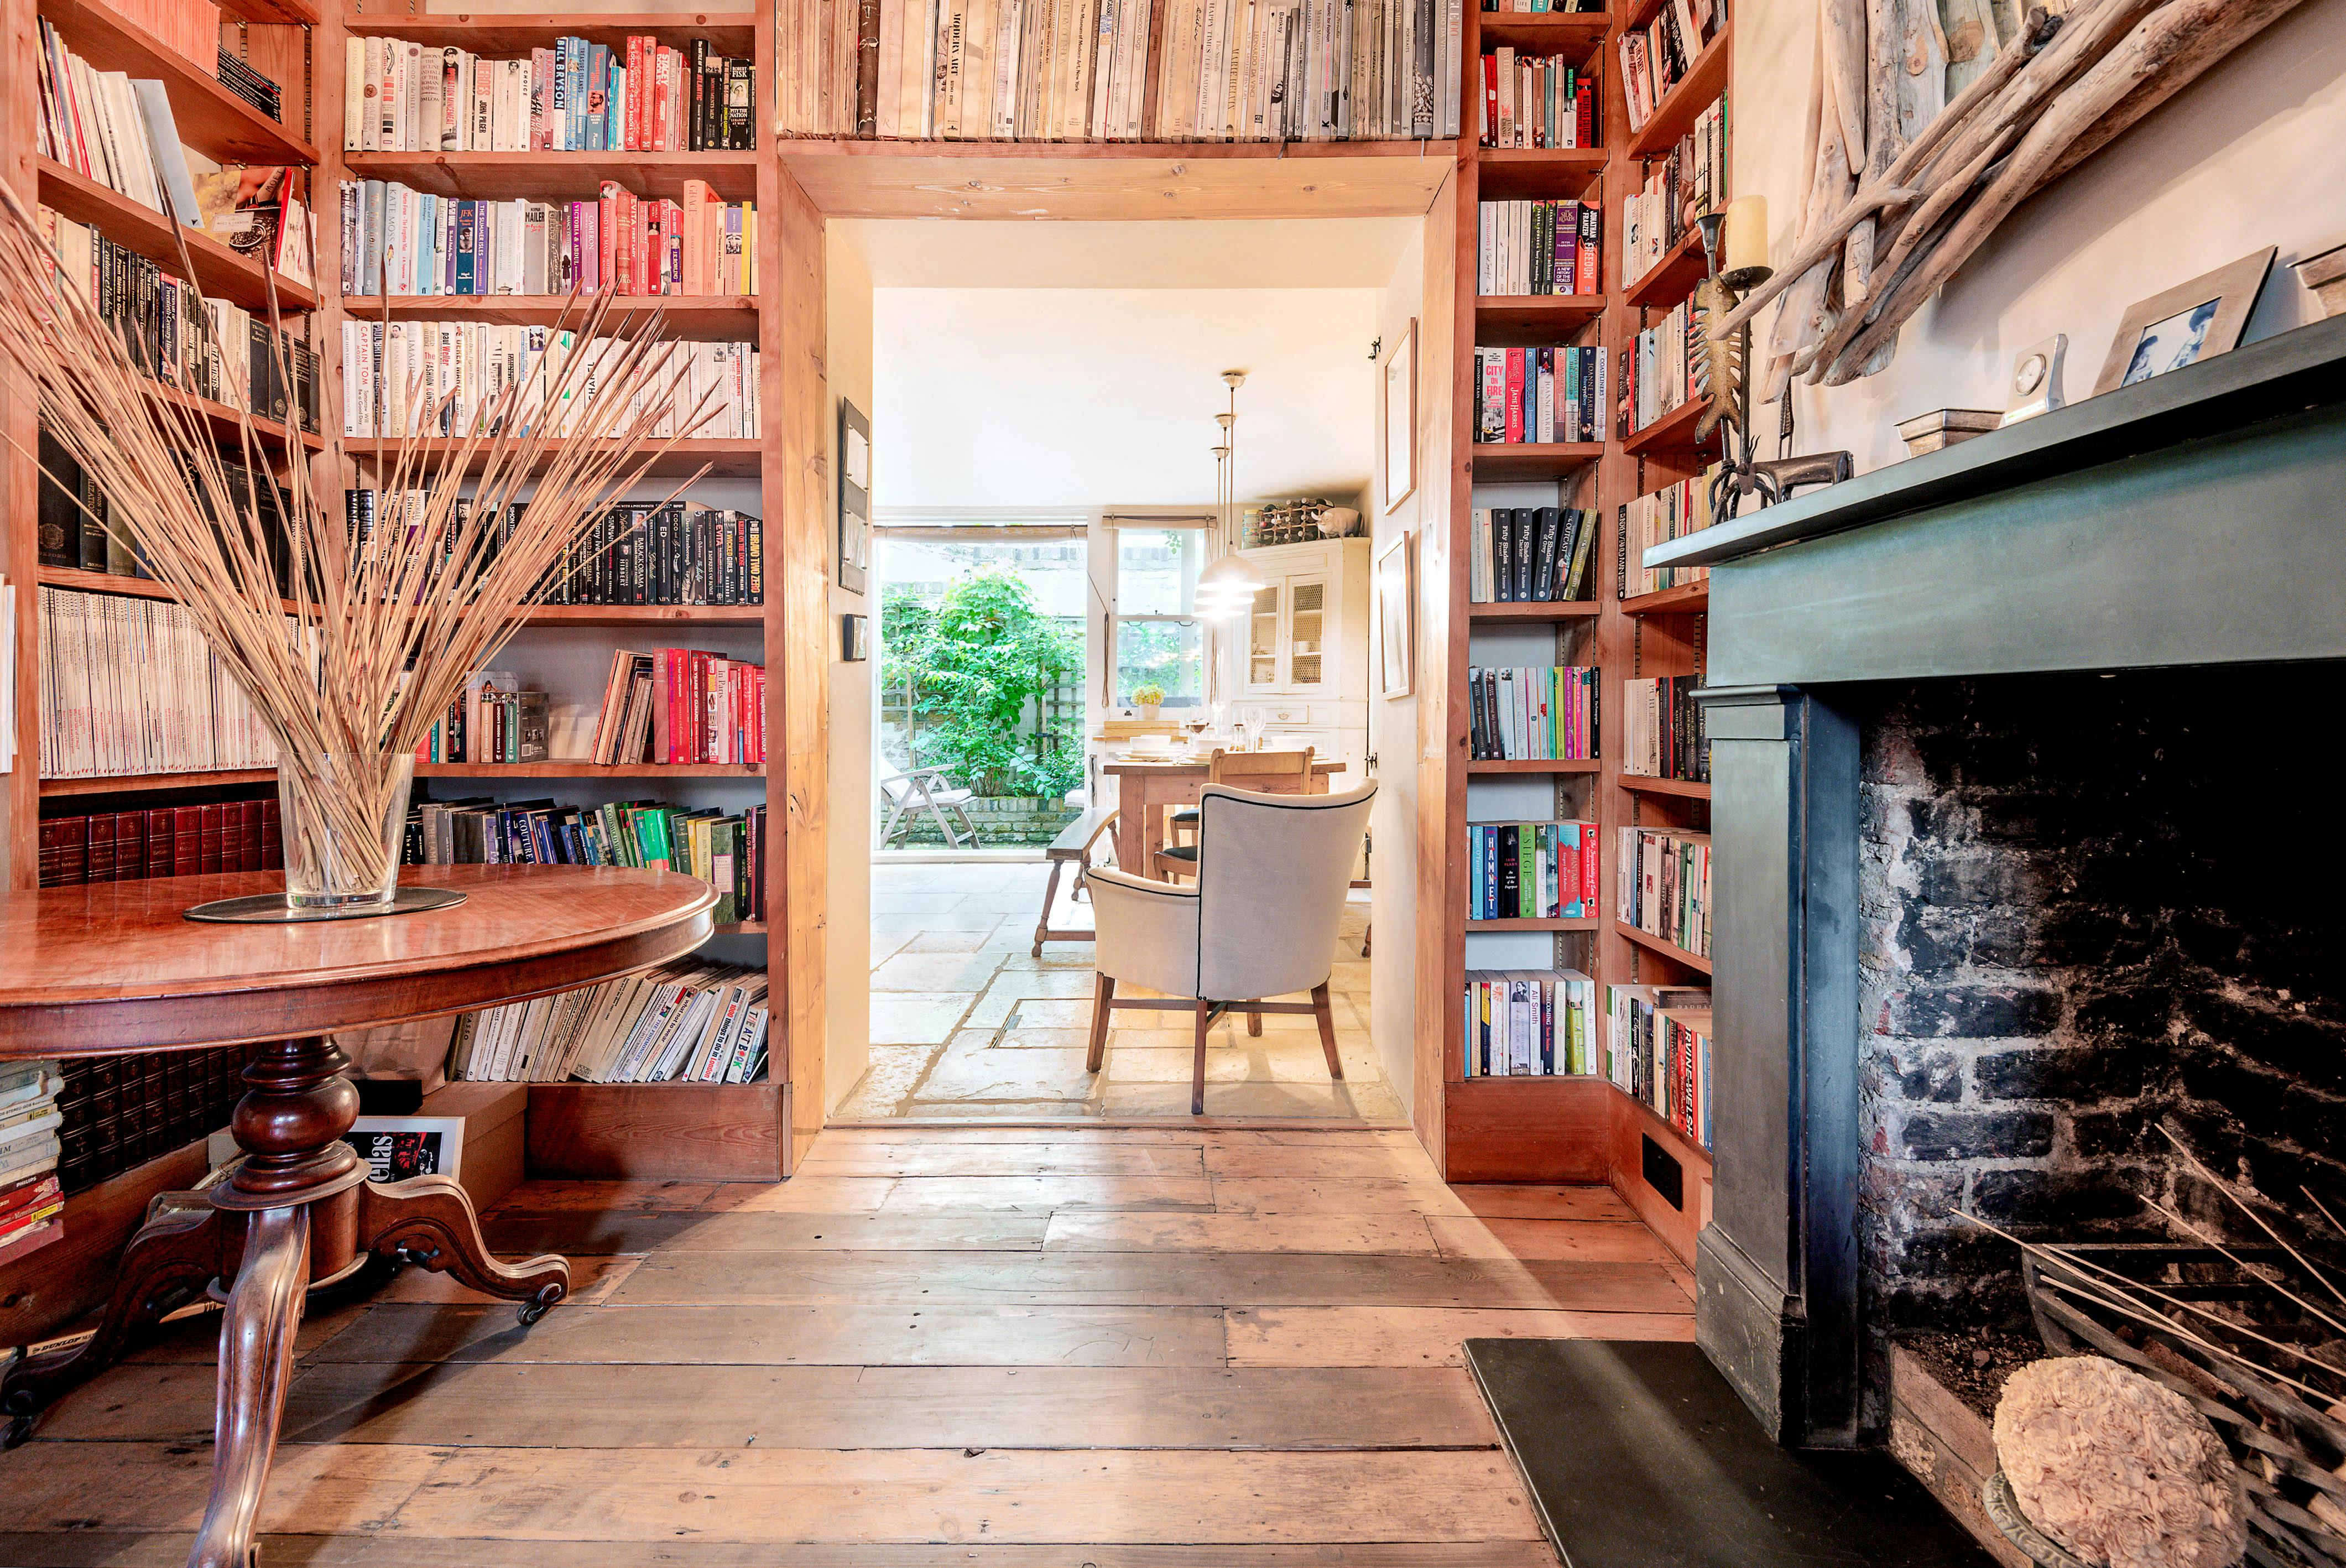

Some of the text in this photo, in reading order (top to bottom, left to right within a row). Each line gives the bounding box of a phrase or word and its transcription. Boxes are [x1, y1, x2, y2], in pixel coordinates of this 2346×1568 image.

[951, 13, 961, 75] MODERN ART
[533, 54, 542, 65] Jay
[1636, 57, 1644, 75] PARTY
[477, 62, 491, 96] HEROES
[555, 39, 565, 108] BILL BRYSON
[1251, 69, 1257, 78] DA
[446, 67, 455, 125] OPERATION MINCEMEAT
[265, 169, 284, 192] MOET
[525, 212, 545, 222] MAILER
[441, 332, 450, 345] paul
[426, 362, 434, 386] FASHION
[1486, 366, 1504, 376] CITY
[1487, 386, 1503, 396] FIRE
[1510, 404, 1519, 428] HARRIS
[660, 527, 667, 538] ED
[1562, 523, 1572, 553] OUTCAST
[750, 534, 760, 593] BRAVO TWO ZERO
[518, 819, 530, 860] COUTURE
[607, 812, 624, 863] COTSWOLD VILLAGE
[1523, 838, 1531, 877] SIEGE
[1488, 837, 1497, 909] HAMNET
[678, 999, 690, 1013] what
[726, 1003, 737, 1018] 1000
[673, 1013, 683, 1023] not
[718, 1017, 731, 1035] things
[633, 1029, 659, 1061] FISHMONGER
[661, 1028, 674, 1043] wear
[715, 1043, 724, 1051] do
[703, 1057, 718, 1079] London
[365, 1136, 393, 1181] ellas
[16, 1176, 37, 1187] PHILIPS
